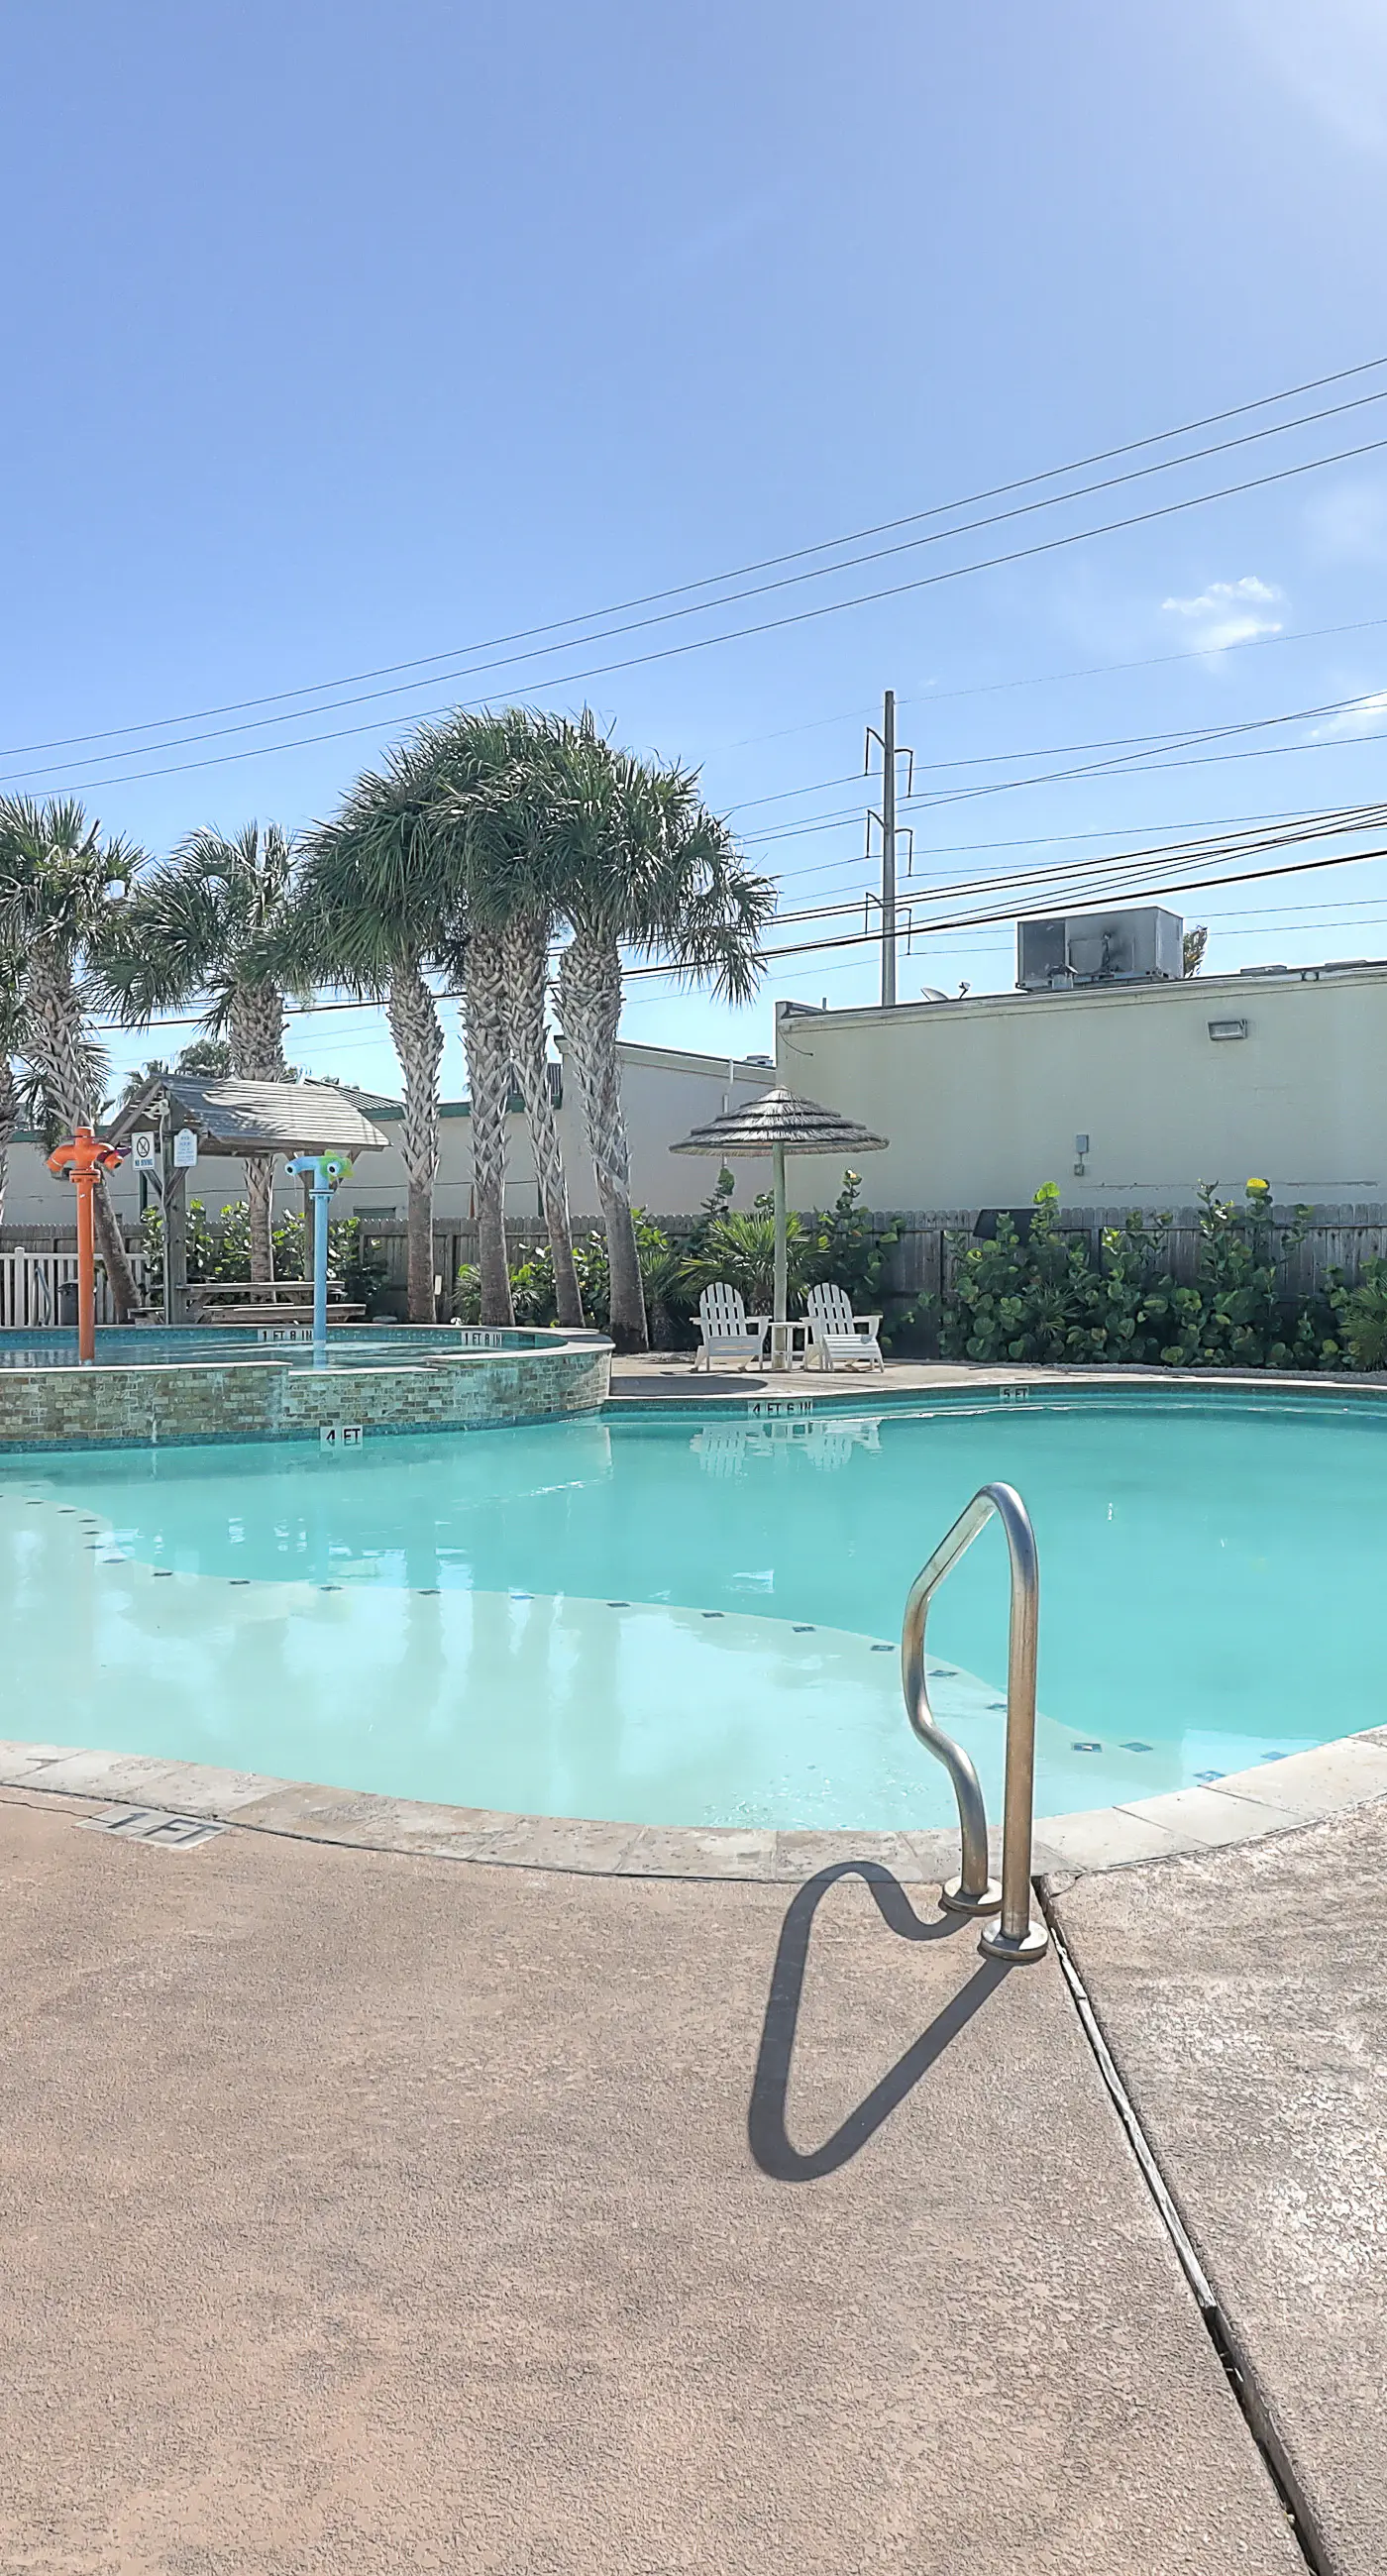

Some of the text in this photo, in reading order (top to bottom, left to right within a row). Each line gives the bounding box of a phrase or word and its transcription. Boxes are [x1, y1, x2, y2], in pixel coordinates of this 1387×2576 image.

[263, 1330, 312, 1342] 1 FT 8 IN
[473, 1333, 481, 1345] FT
[492, 1333, 501, 1347] IN
[1004, 1388, 1027, 1399] 5 FT
[752, 1403, 761, 1414] 4
[767, 1403, 782, 1414] FT
[800, 1401, 811, 1414] IN
[326, 1428, 361, 1443] 4 FT
[107, 1812, 222, 1843] 1 FT
